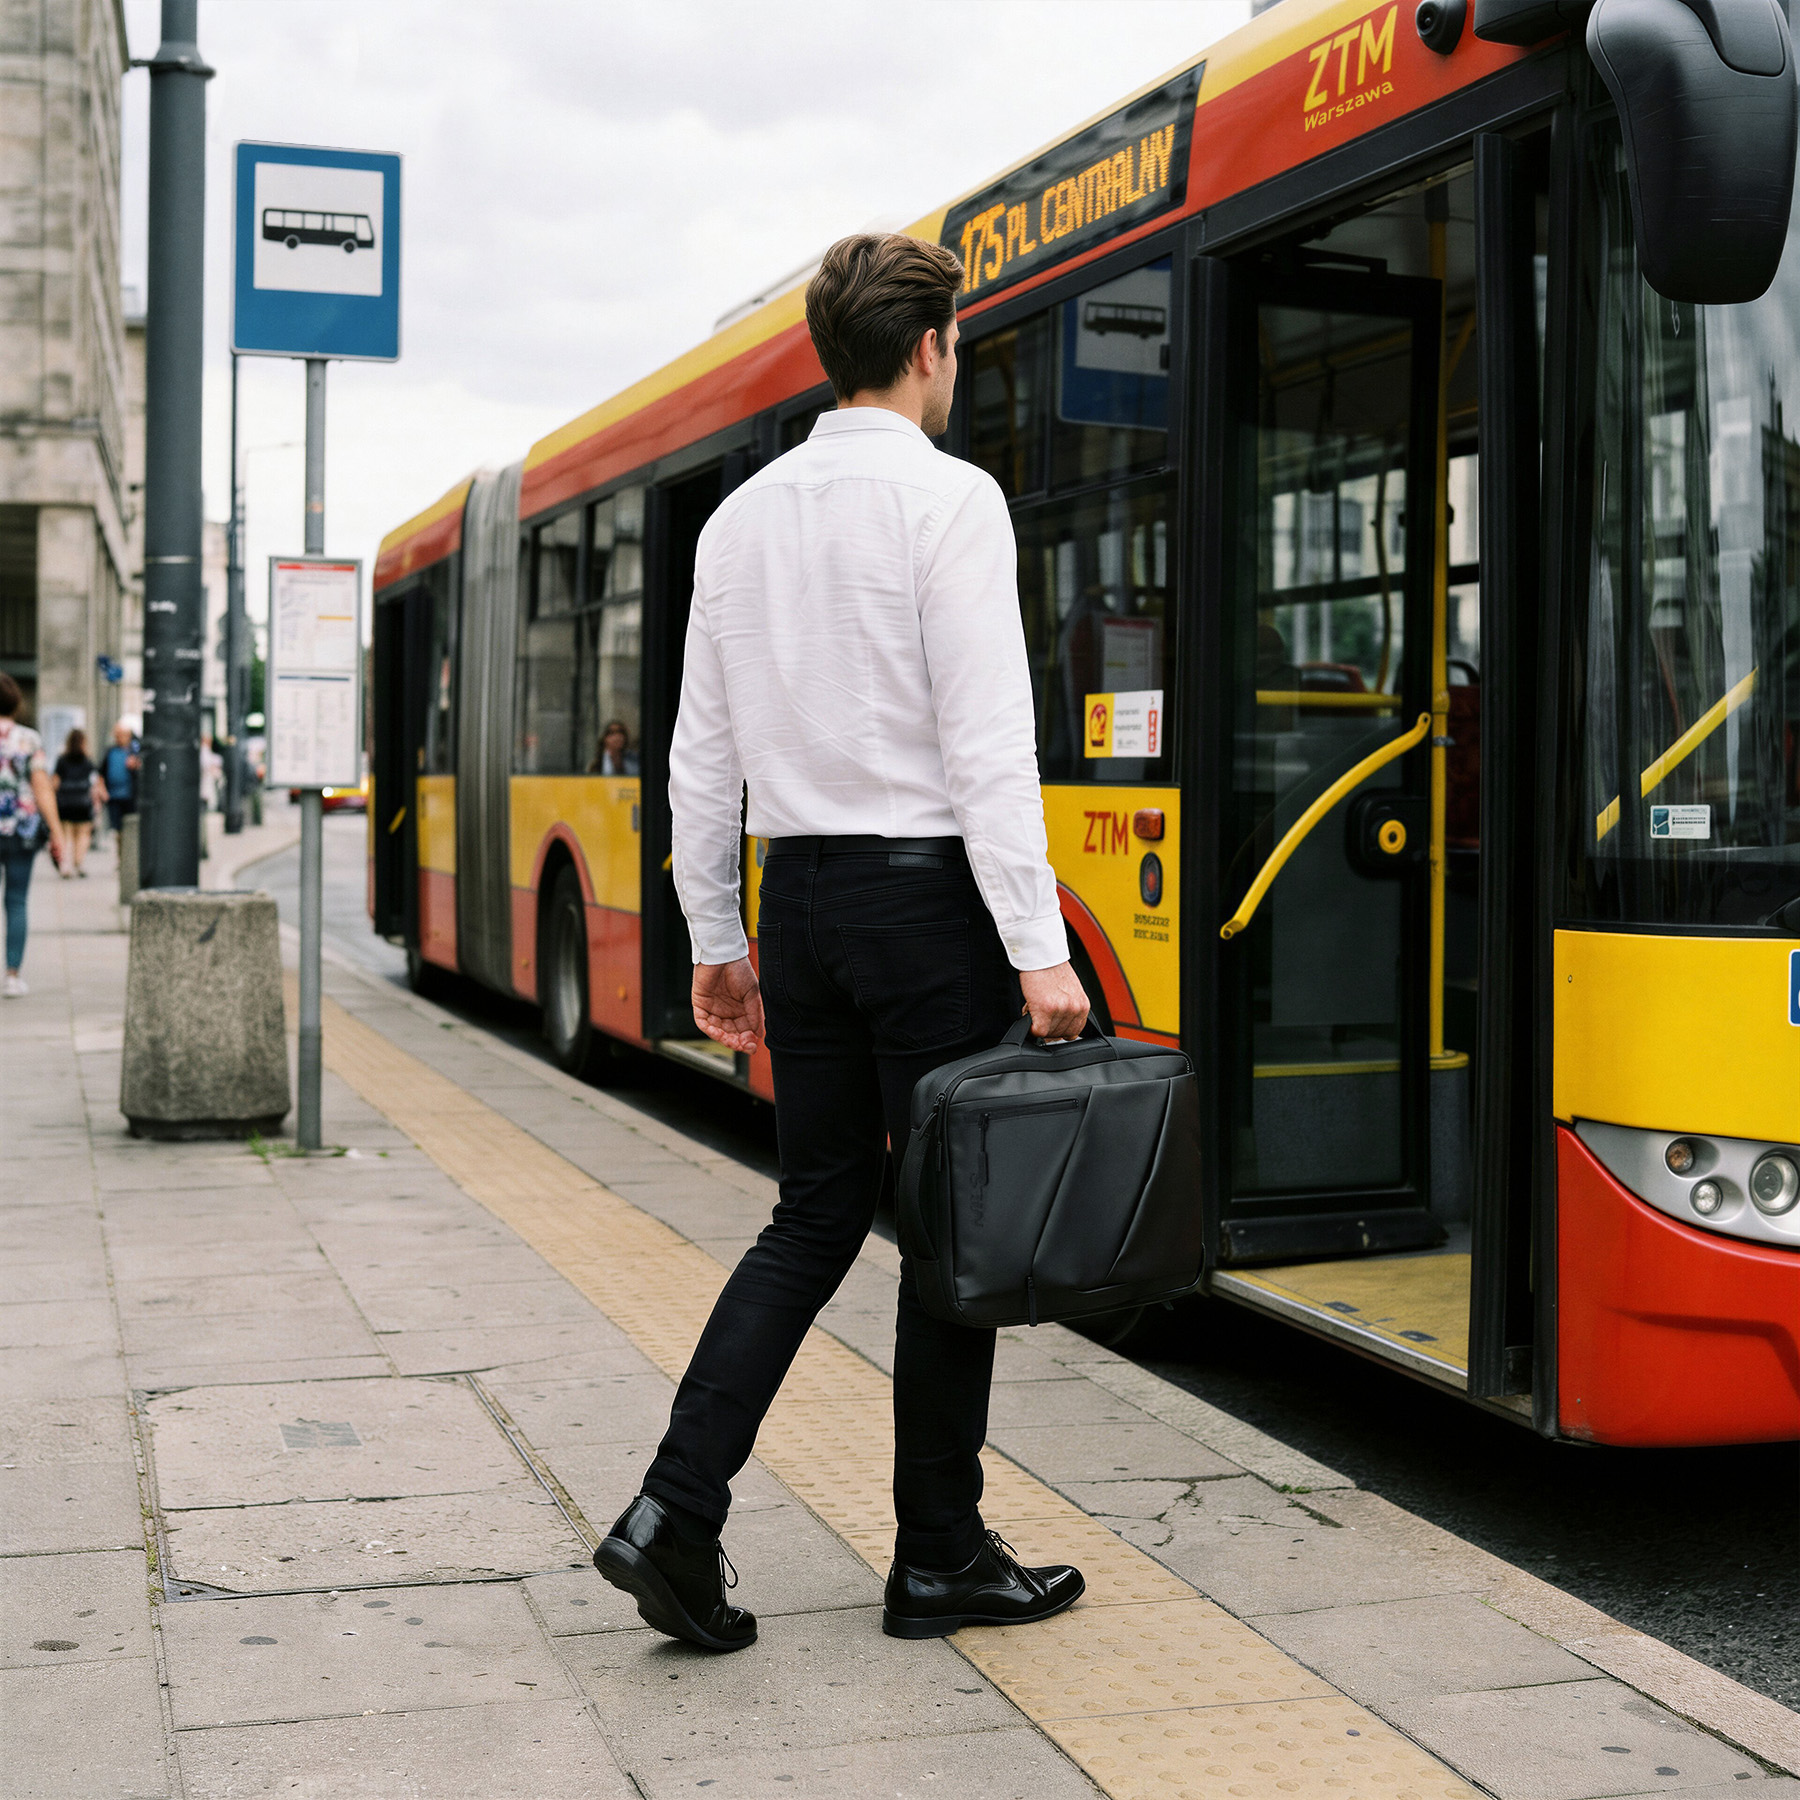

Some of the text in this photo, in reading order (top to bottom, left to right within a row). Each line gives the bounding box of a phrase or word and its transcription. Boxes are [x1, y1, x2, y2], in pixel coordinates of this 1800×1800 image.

[1303, 5, 1398, 112] ZTM
[1305, 82, 1394, 132] Warszawa
[960, 203, 1005, 293] 175
[1084, 811, 1128, 855] ZTM
